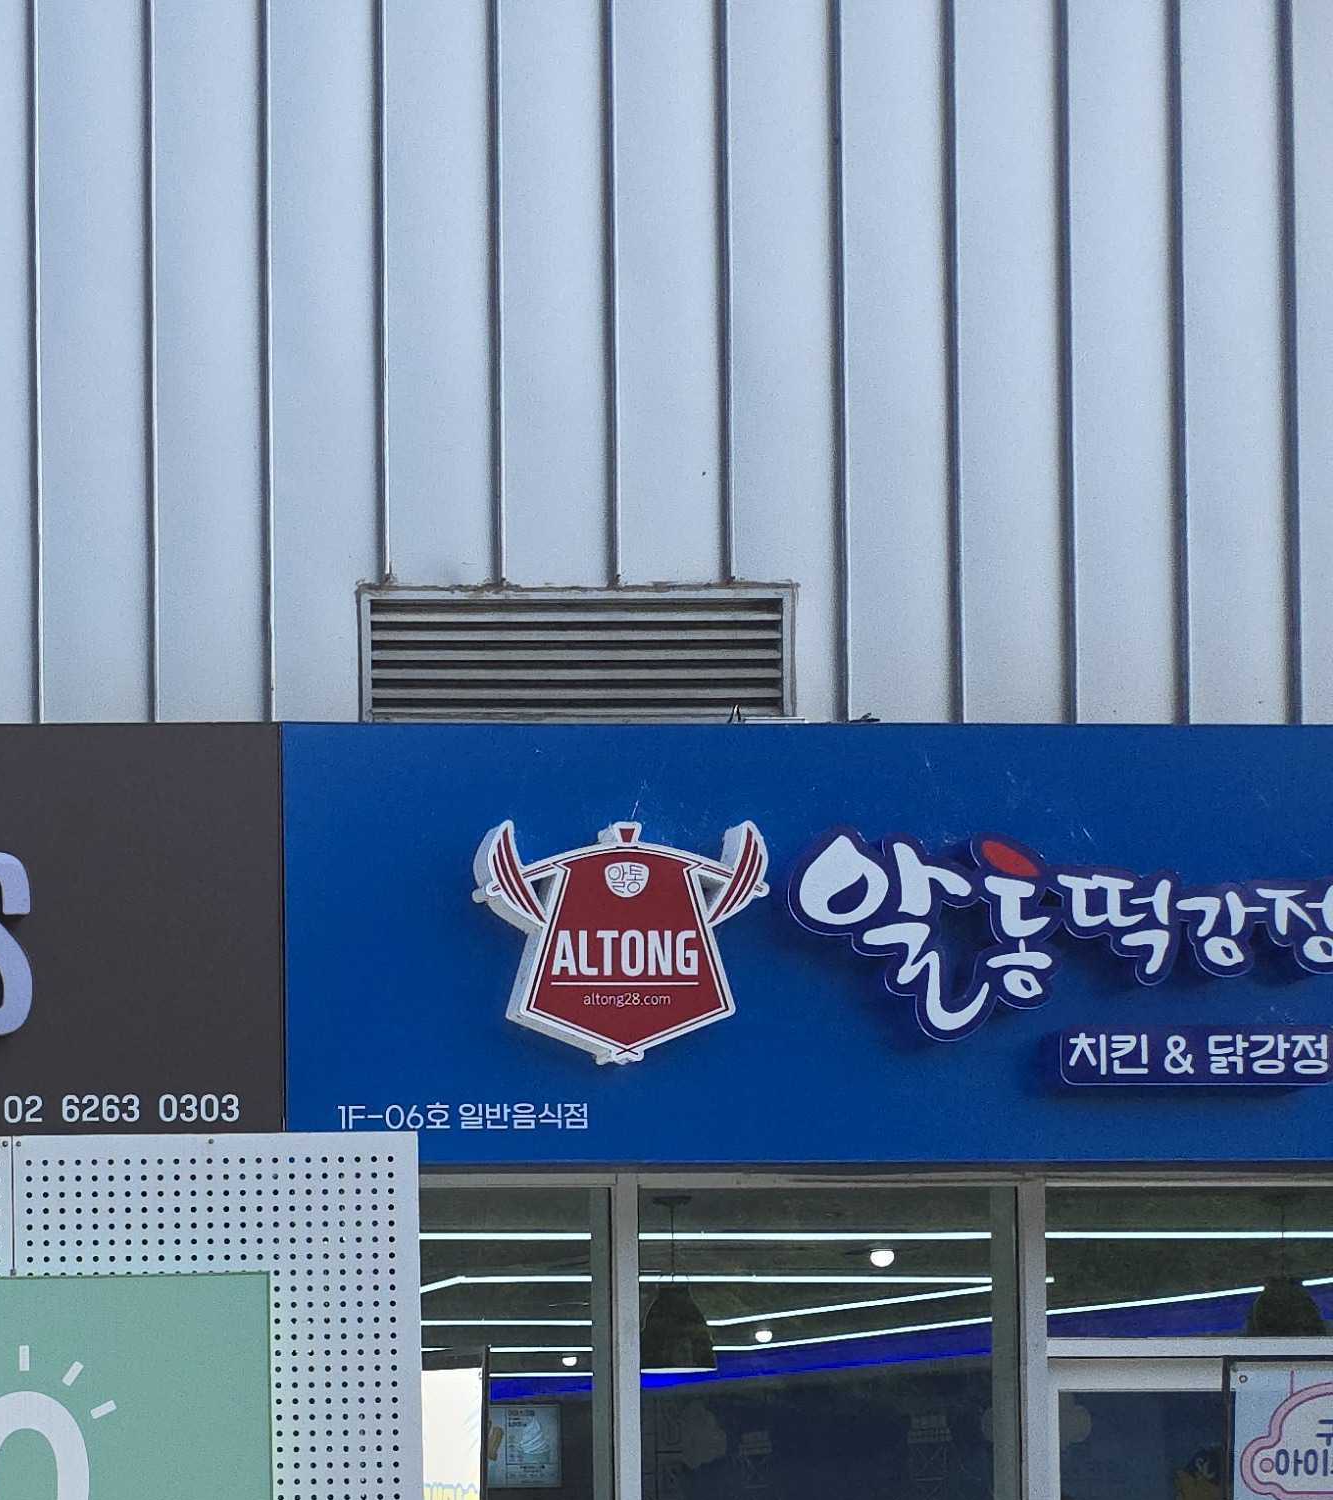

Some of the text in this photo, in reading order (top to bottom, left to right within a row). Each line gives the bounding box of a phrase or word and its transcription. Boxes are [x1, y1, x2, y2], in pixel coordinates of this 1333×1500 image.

[551, 929, 700, 977] ALTONG
[583, 991, 672, 1008] altong28.com
[1068, 1032, 1330, 1076] 치킨 & 닭강정
[3, 1095, 44, 1124] 02
[61, 1094, 141, 1123] 6263
[158, 1094, 241, 1122] 0303
[337, 1102, 589, 1130] 1F-06호 일반음식점
[1275, 1448, 1333, 1477] 아이
